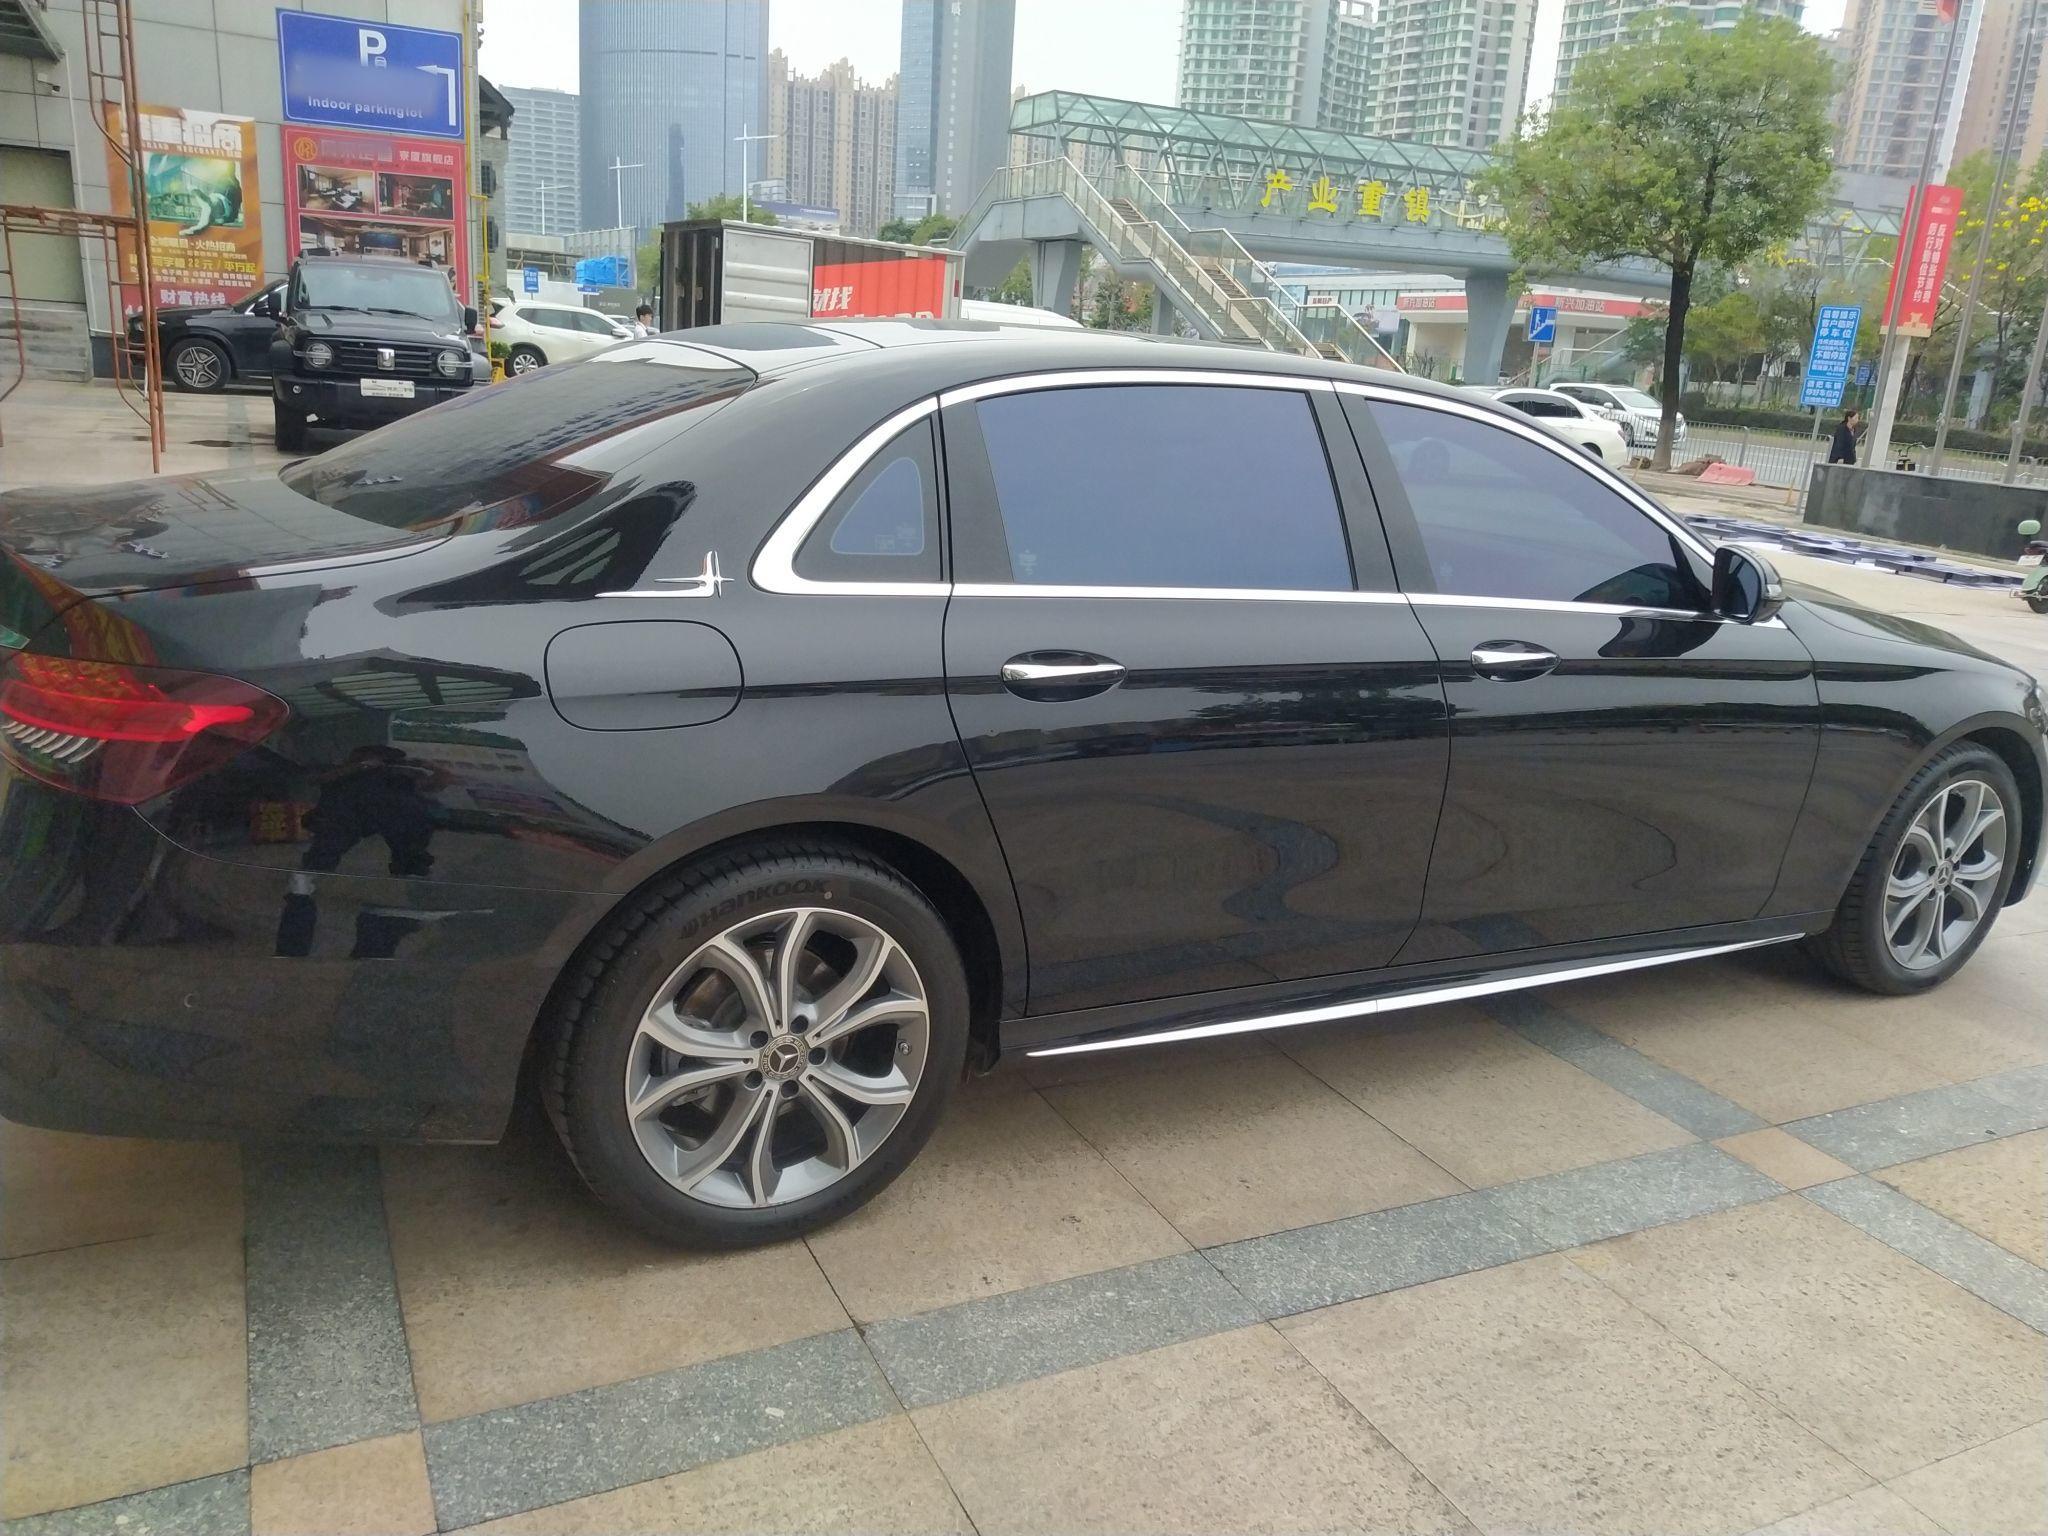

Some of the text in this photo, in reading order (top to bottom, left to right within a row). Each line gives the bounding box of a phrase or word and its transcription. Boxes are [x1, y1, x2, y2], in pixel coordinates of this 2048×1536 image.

[308, 95, 351, 111] Indoor
[160, 289, 226, 306] 财富热线
[1555, 296, 1605, 312] 新兴加油站
[1819, 327, 1852, 339] 停车位
